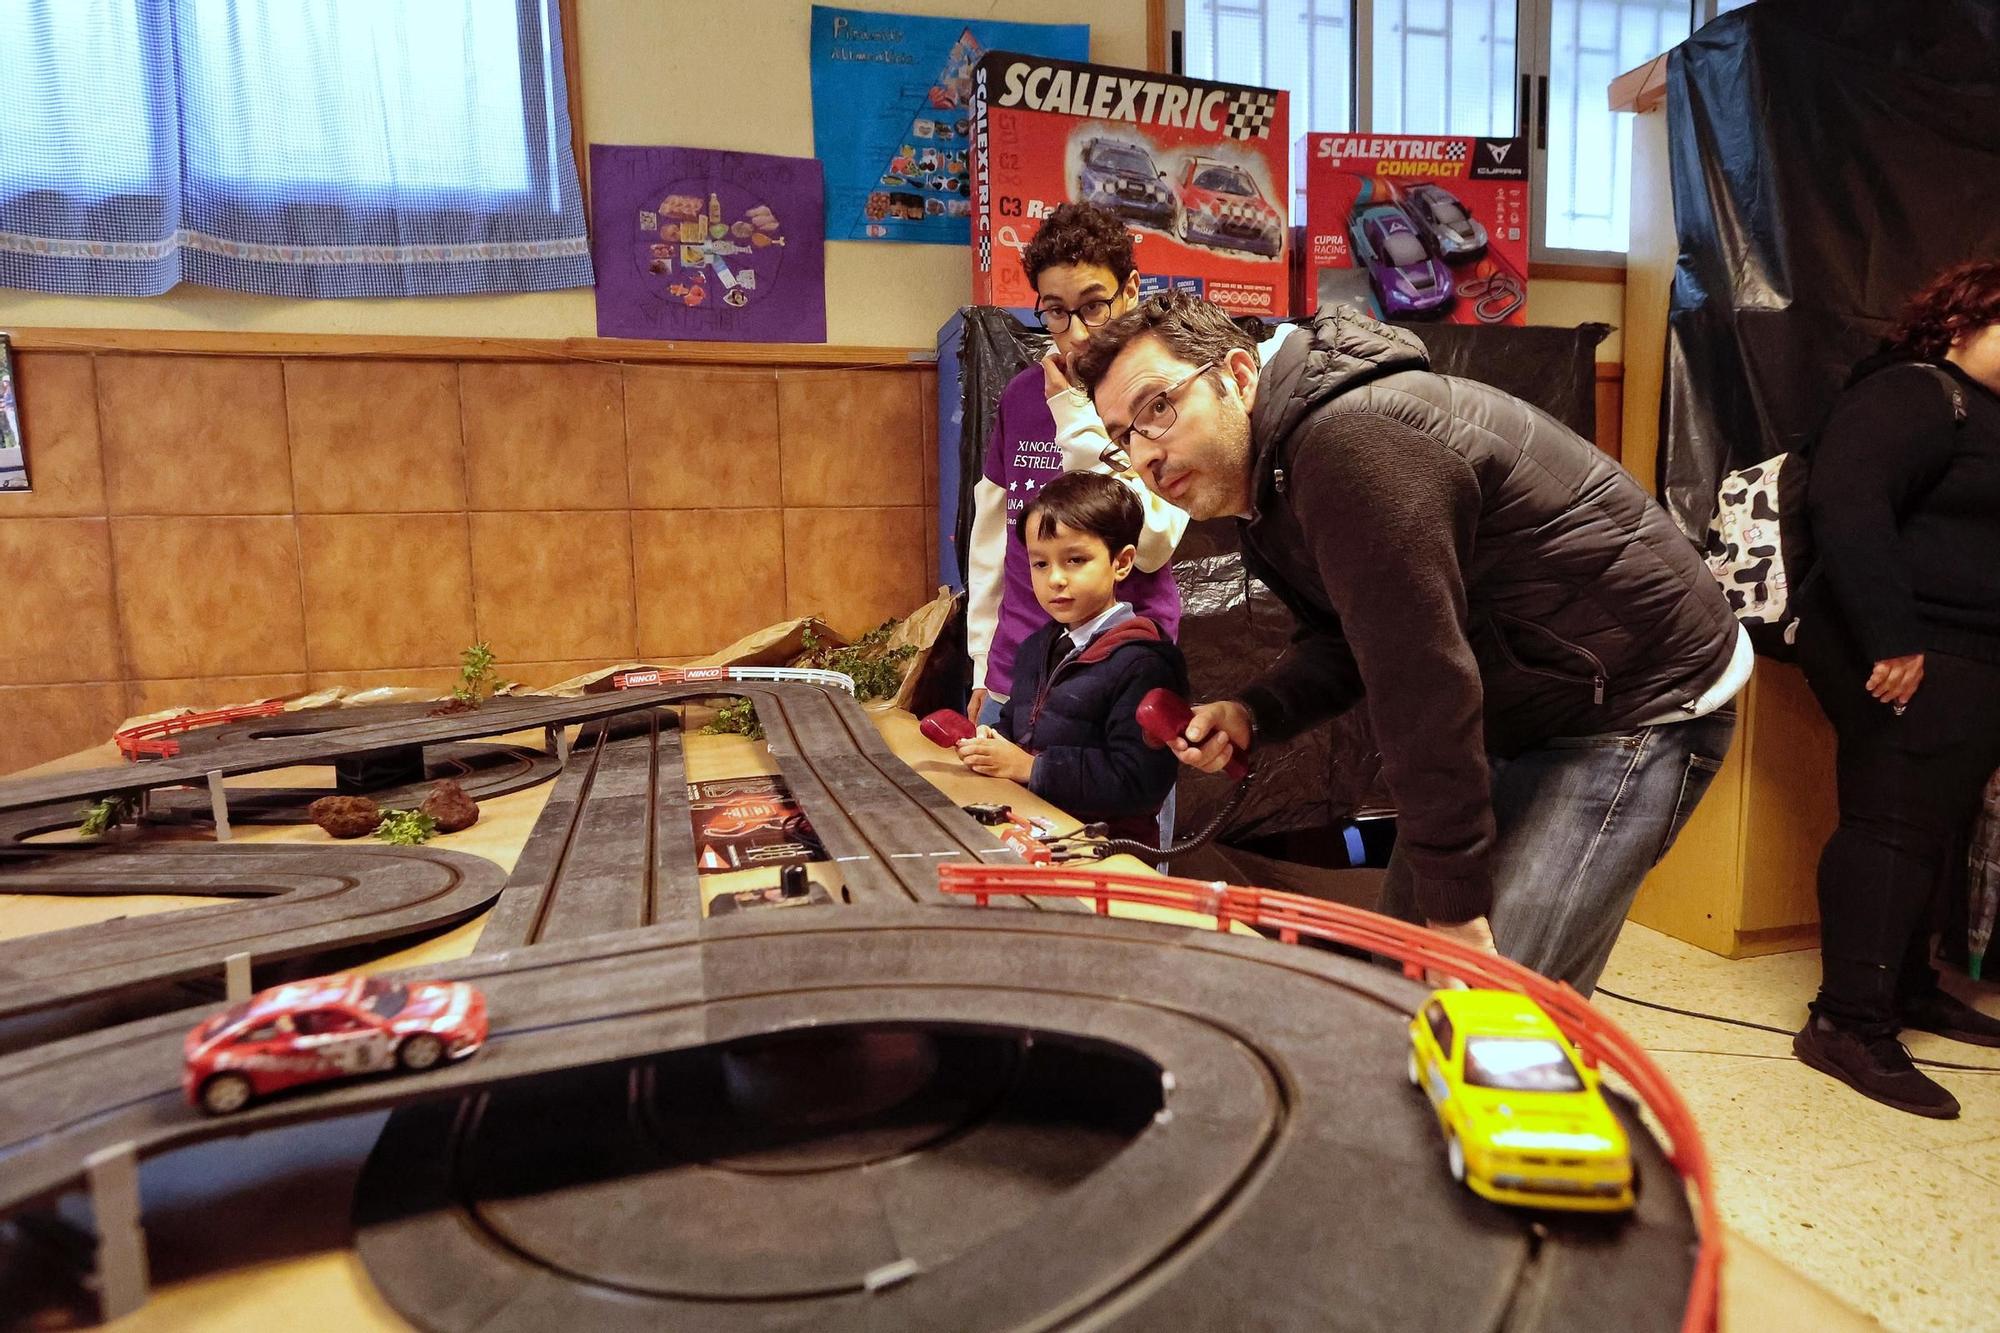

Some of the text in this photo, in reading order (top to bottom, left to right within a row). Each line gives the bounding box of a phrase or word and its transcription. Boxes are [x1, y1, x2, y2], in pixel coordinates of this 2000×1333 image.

[998, 62, 1226, 132] SCALEXTRIC
[976, 67, 990, 231] SCALEXTRIC
[1317, 137, 1446, 160] SCALEXTRIC
[1375, 160, 1464, 177] COMPACT
[1000, 196, 1021, 216] C3
[1314, 235, 1343, 244] CUPRA
[1314, 245, 1347, 254] RACING
[629, 674, 657, 683] NINCO
[687, 669, 720, 678] NINCO
